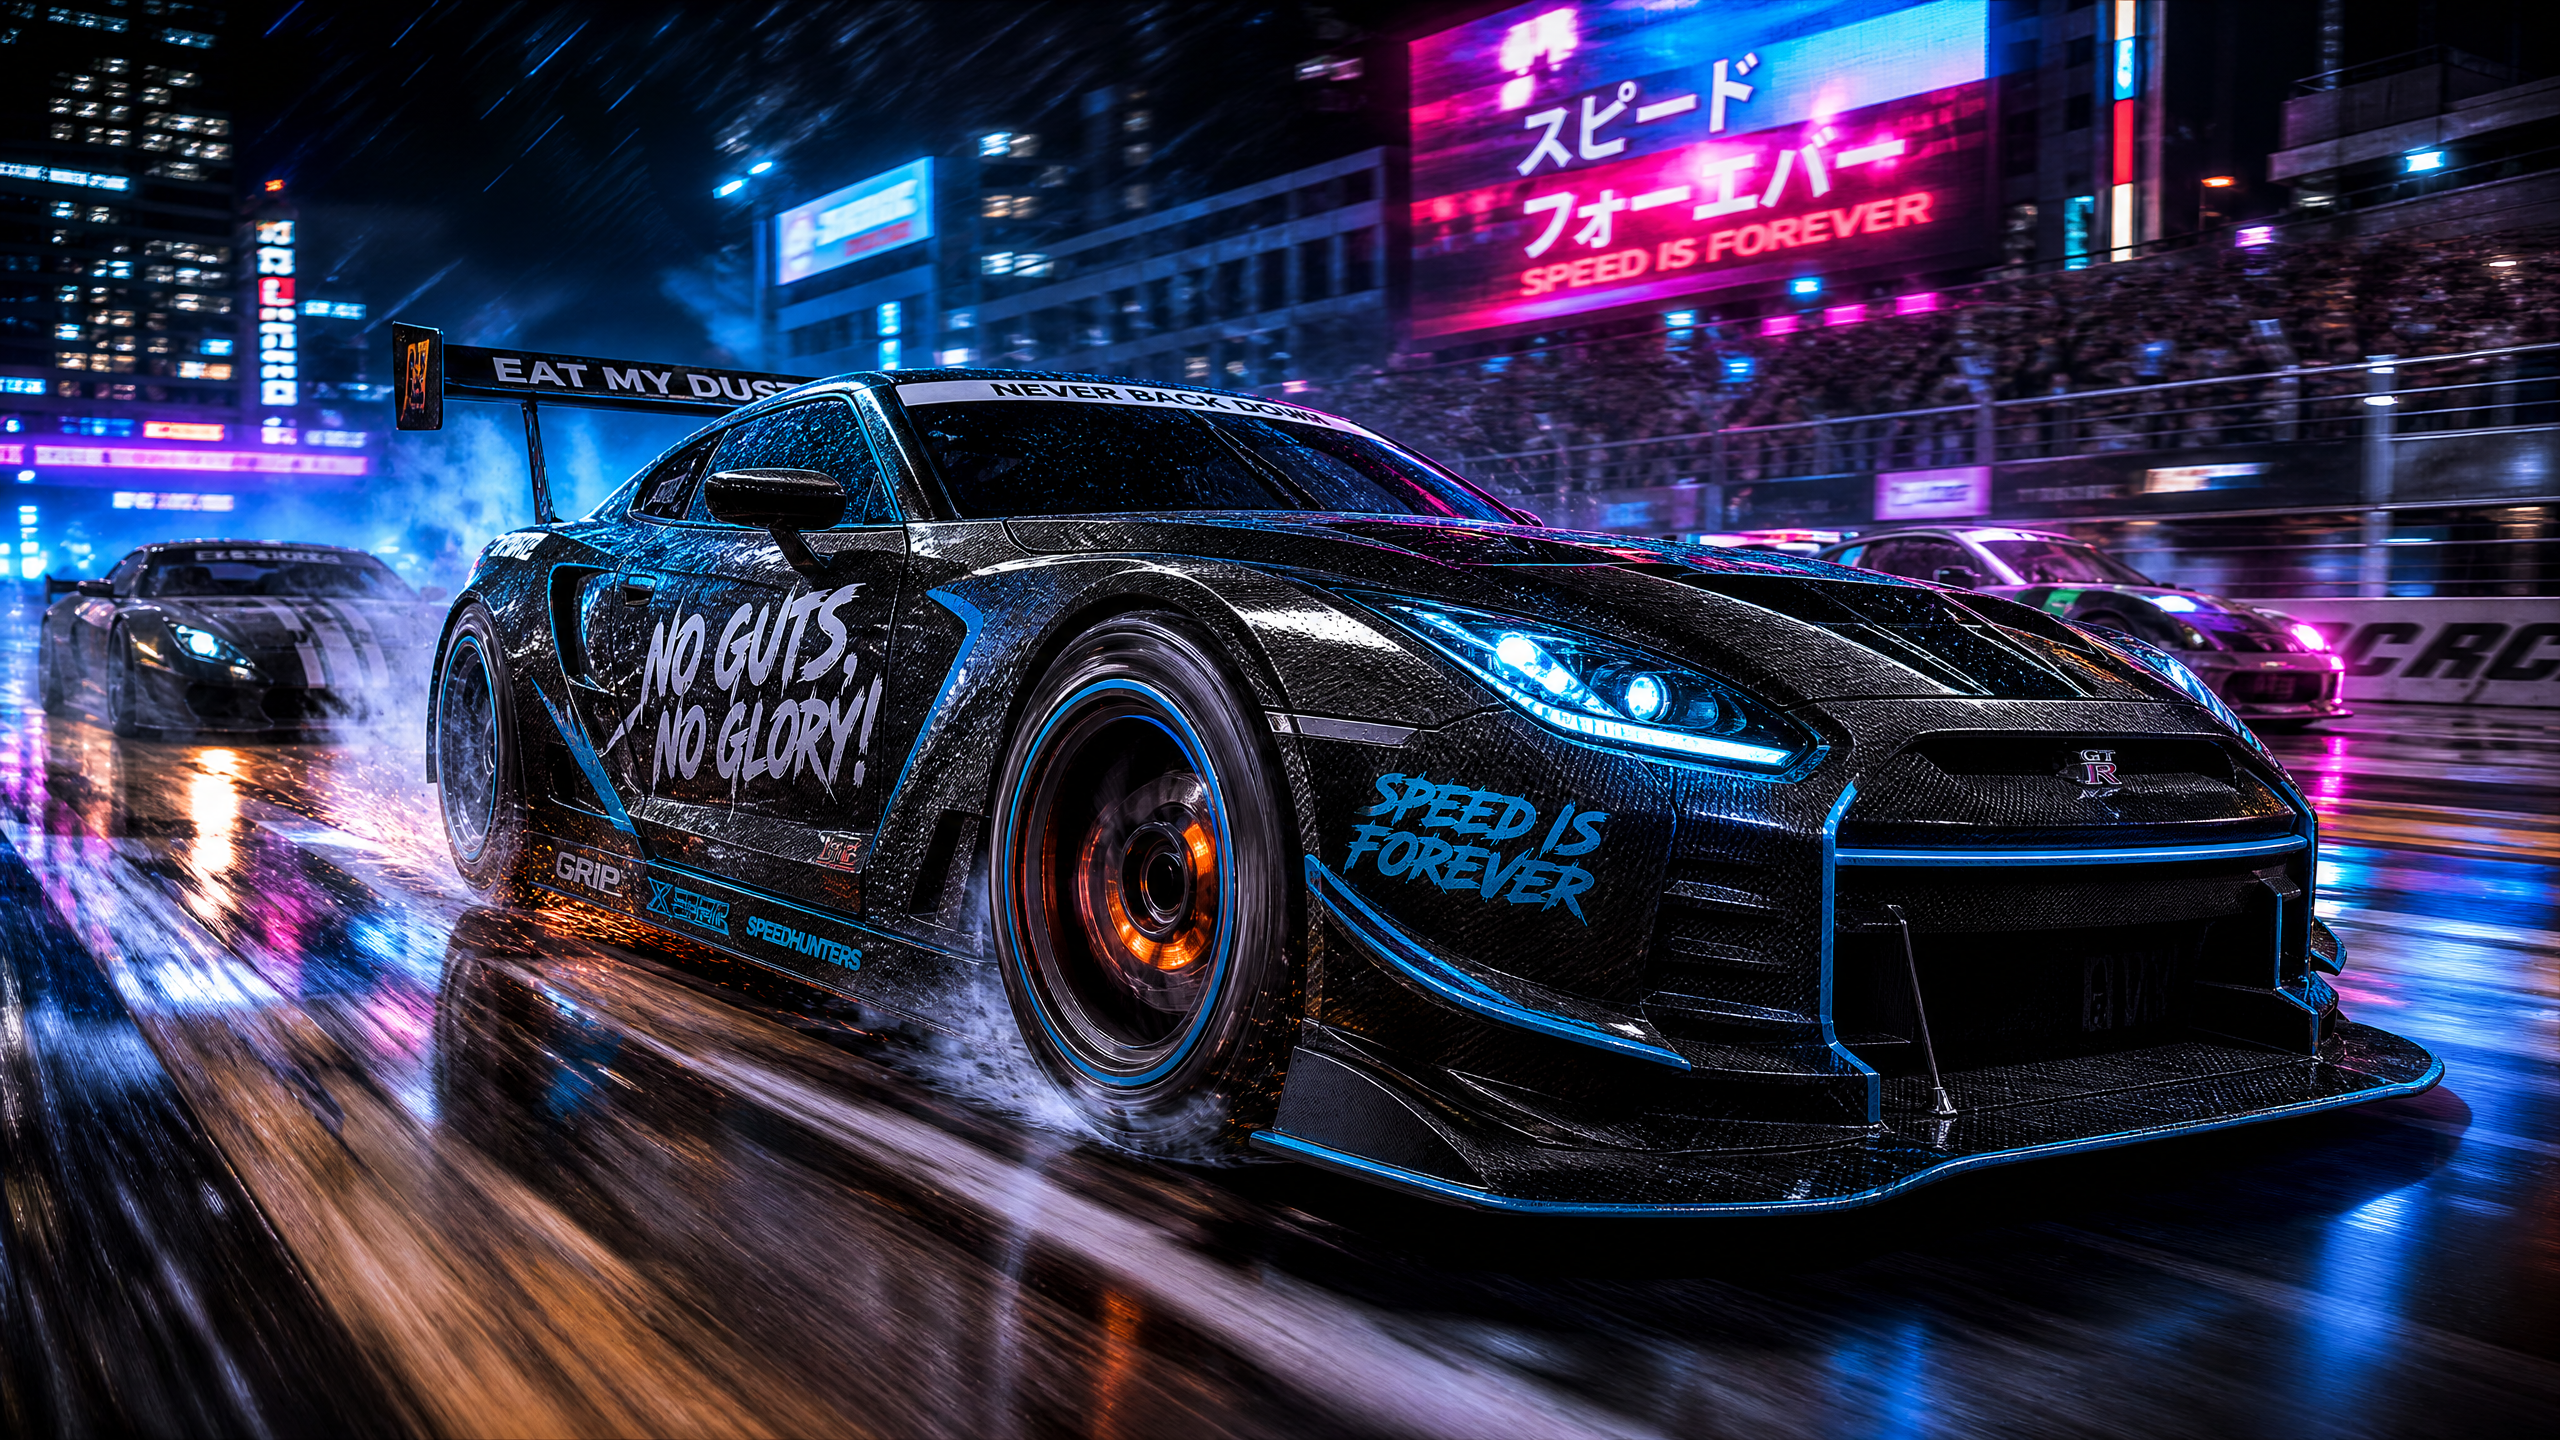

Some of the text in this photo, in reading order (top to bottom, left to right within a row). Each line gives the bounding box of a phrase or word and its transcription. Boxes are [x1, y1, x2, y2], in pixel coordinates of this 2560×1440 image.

[1517, 52, 1758, 176] スピード
[1523, 126, 1906, 258] フォーエバー
[1520, 191, 1935, 297] SPEED IS FOREVER
[492, 356, 588, 388] EAT
[602, 366, 673, 395] MY
[990, 382, 1123, 401] NEVER
[1125, 387, 1231, 410] BACK
[632, 579, 867, 724] NO GUTS,
[2314, 621, 2560, 682] CRC
[651, 673, 883, 810] NO GLORY!
[2080, 761, 2123, 785] R
[1354, 770, 1610, 859] SPEED IS
[1343, 820, 1595, 927] FOREVER
[746, 915, 863, 971] SPEEDHUNTERS
